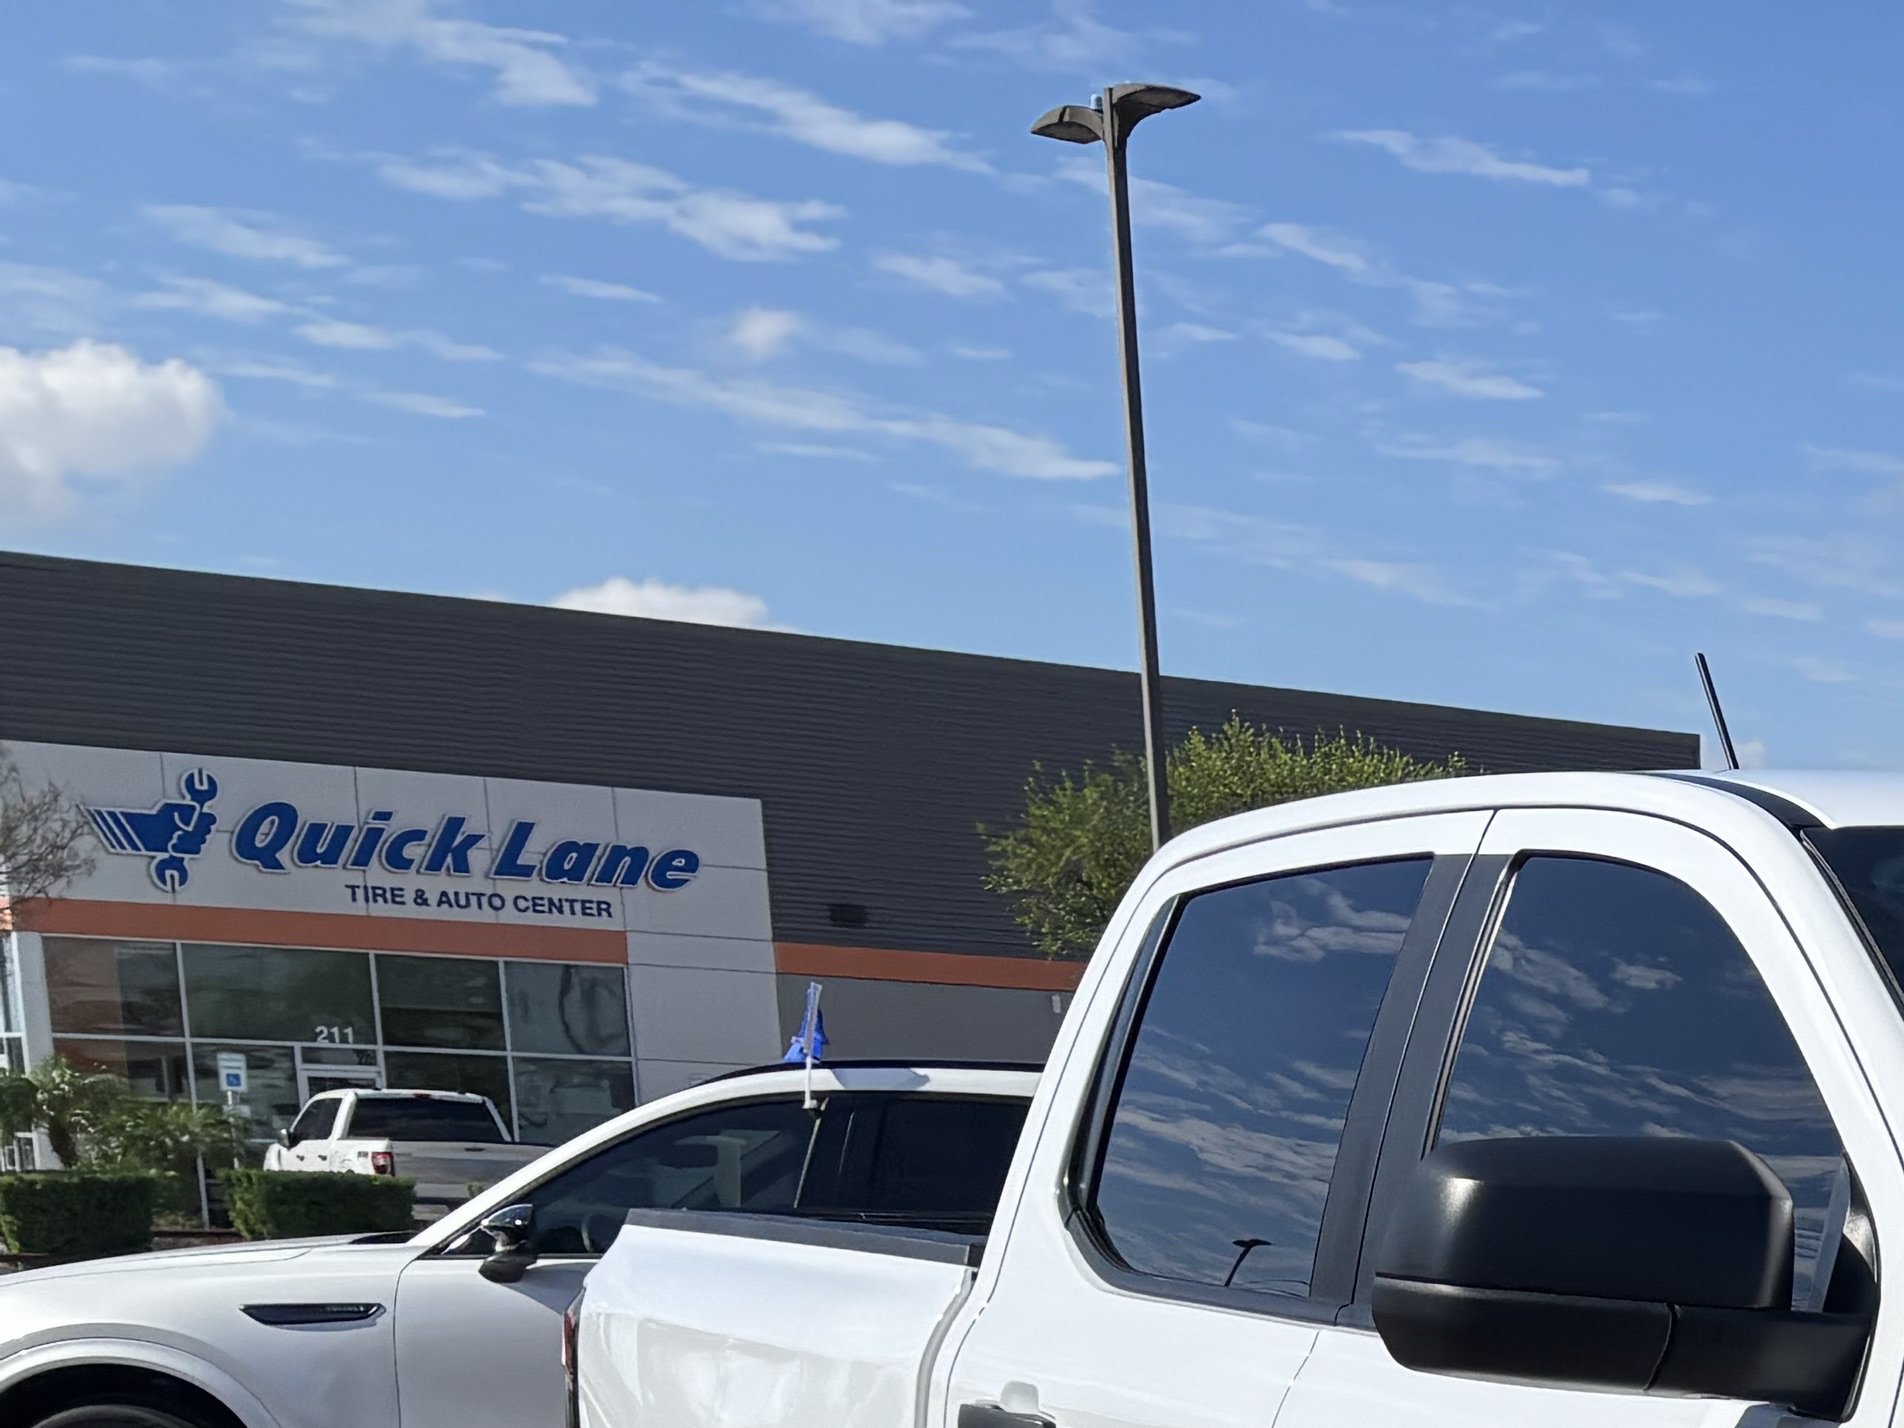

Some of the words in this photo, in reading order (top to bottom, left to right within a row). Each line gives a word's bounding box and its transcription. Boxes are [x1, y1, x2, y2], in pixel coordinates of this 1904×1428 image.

[233, 800, 488, 874] Quick
[491, 820, 701, 892] Lane
[344, 884, 406, 906] TIRE
[414, 888, 431, 907] &
[437, 890, 505, 912] AUTO
[513, 894, 612, 919] CENTER
[314, 1025, 354, 1044] 211
